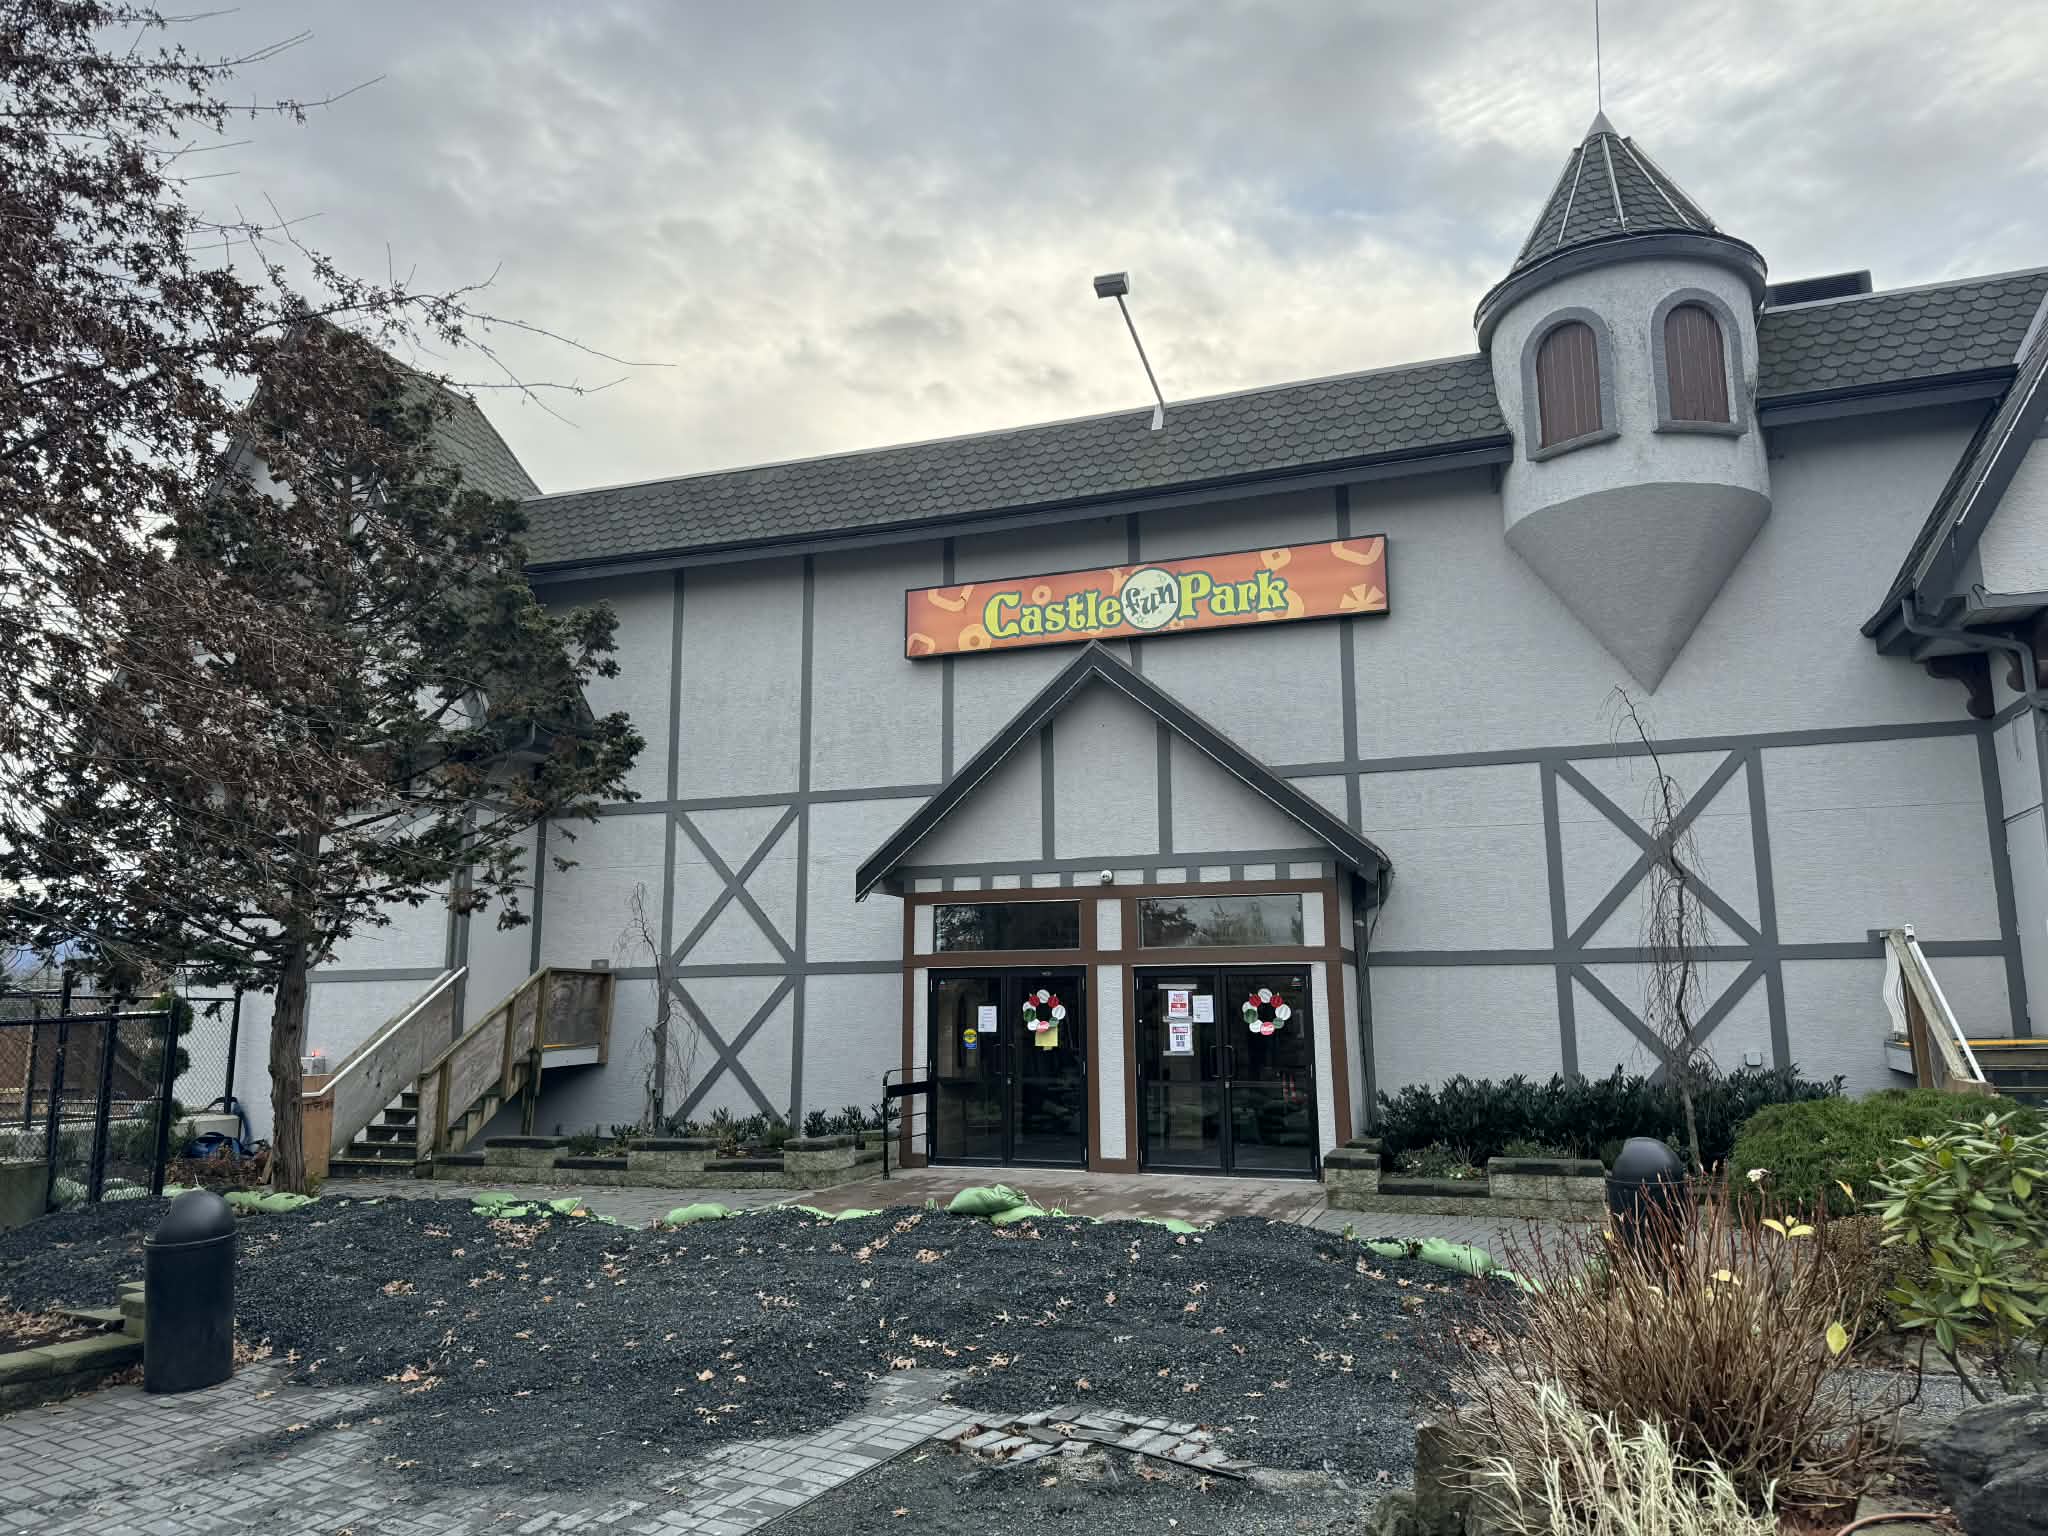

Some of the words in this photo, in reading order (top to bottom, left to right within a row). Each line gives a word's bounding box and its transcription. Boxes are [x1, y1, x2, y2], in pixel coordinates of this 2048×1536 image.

[985, 591, 1122, 638] Castle
[1125, 583, 1177, 616] fun
[1177, 571, 1288, 619] Park
